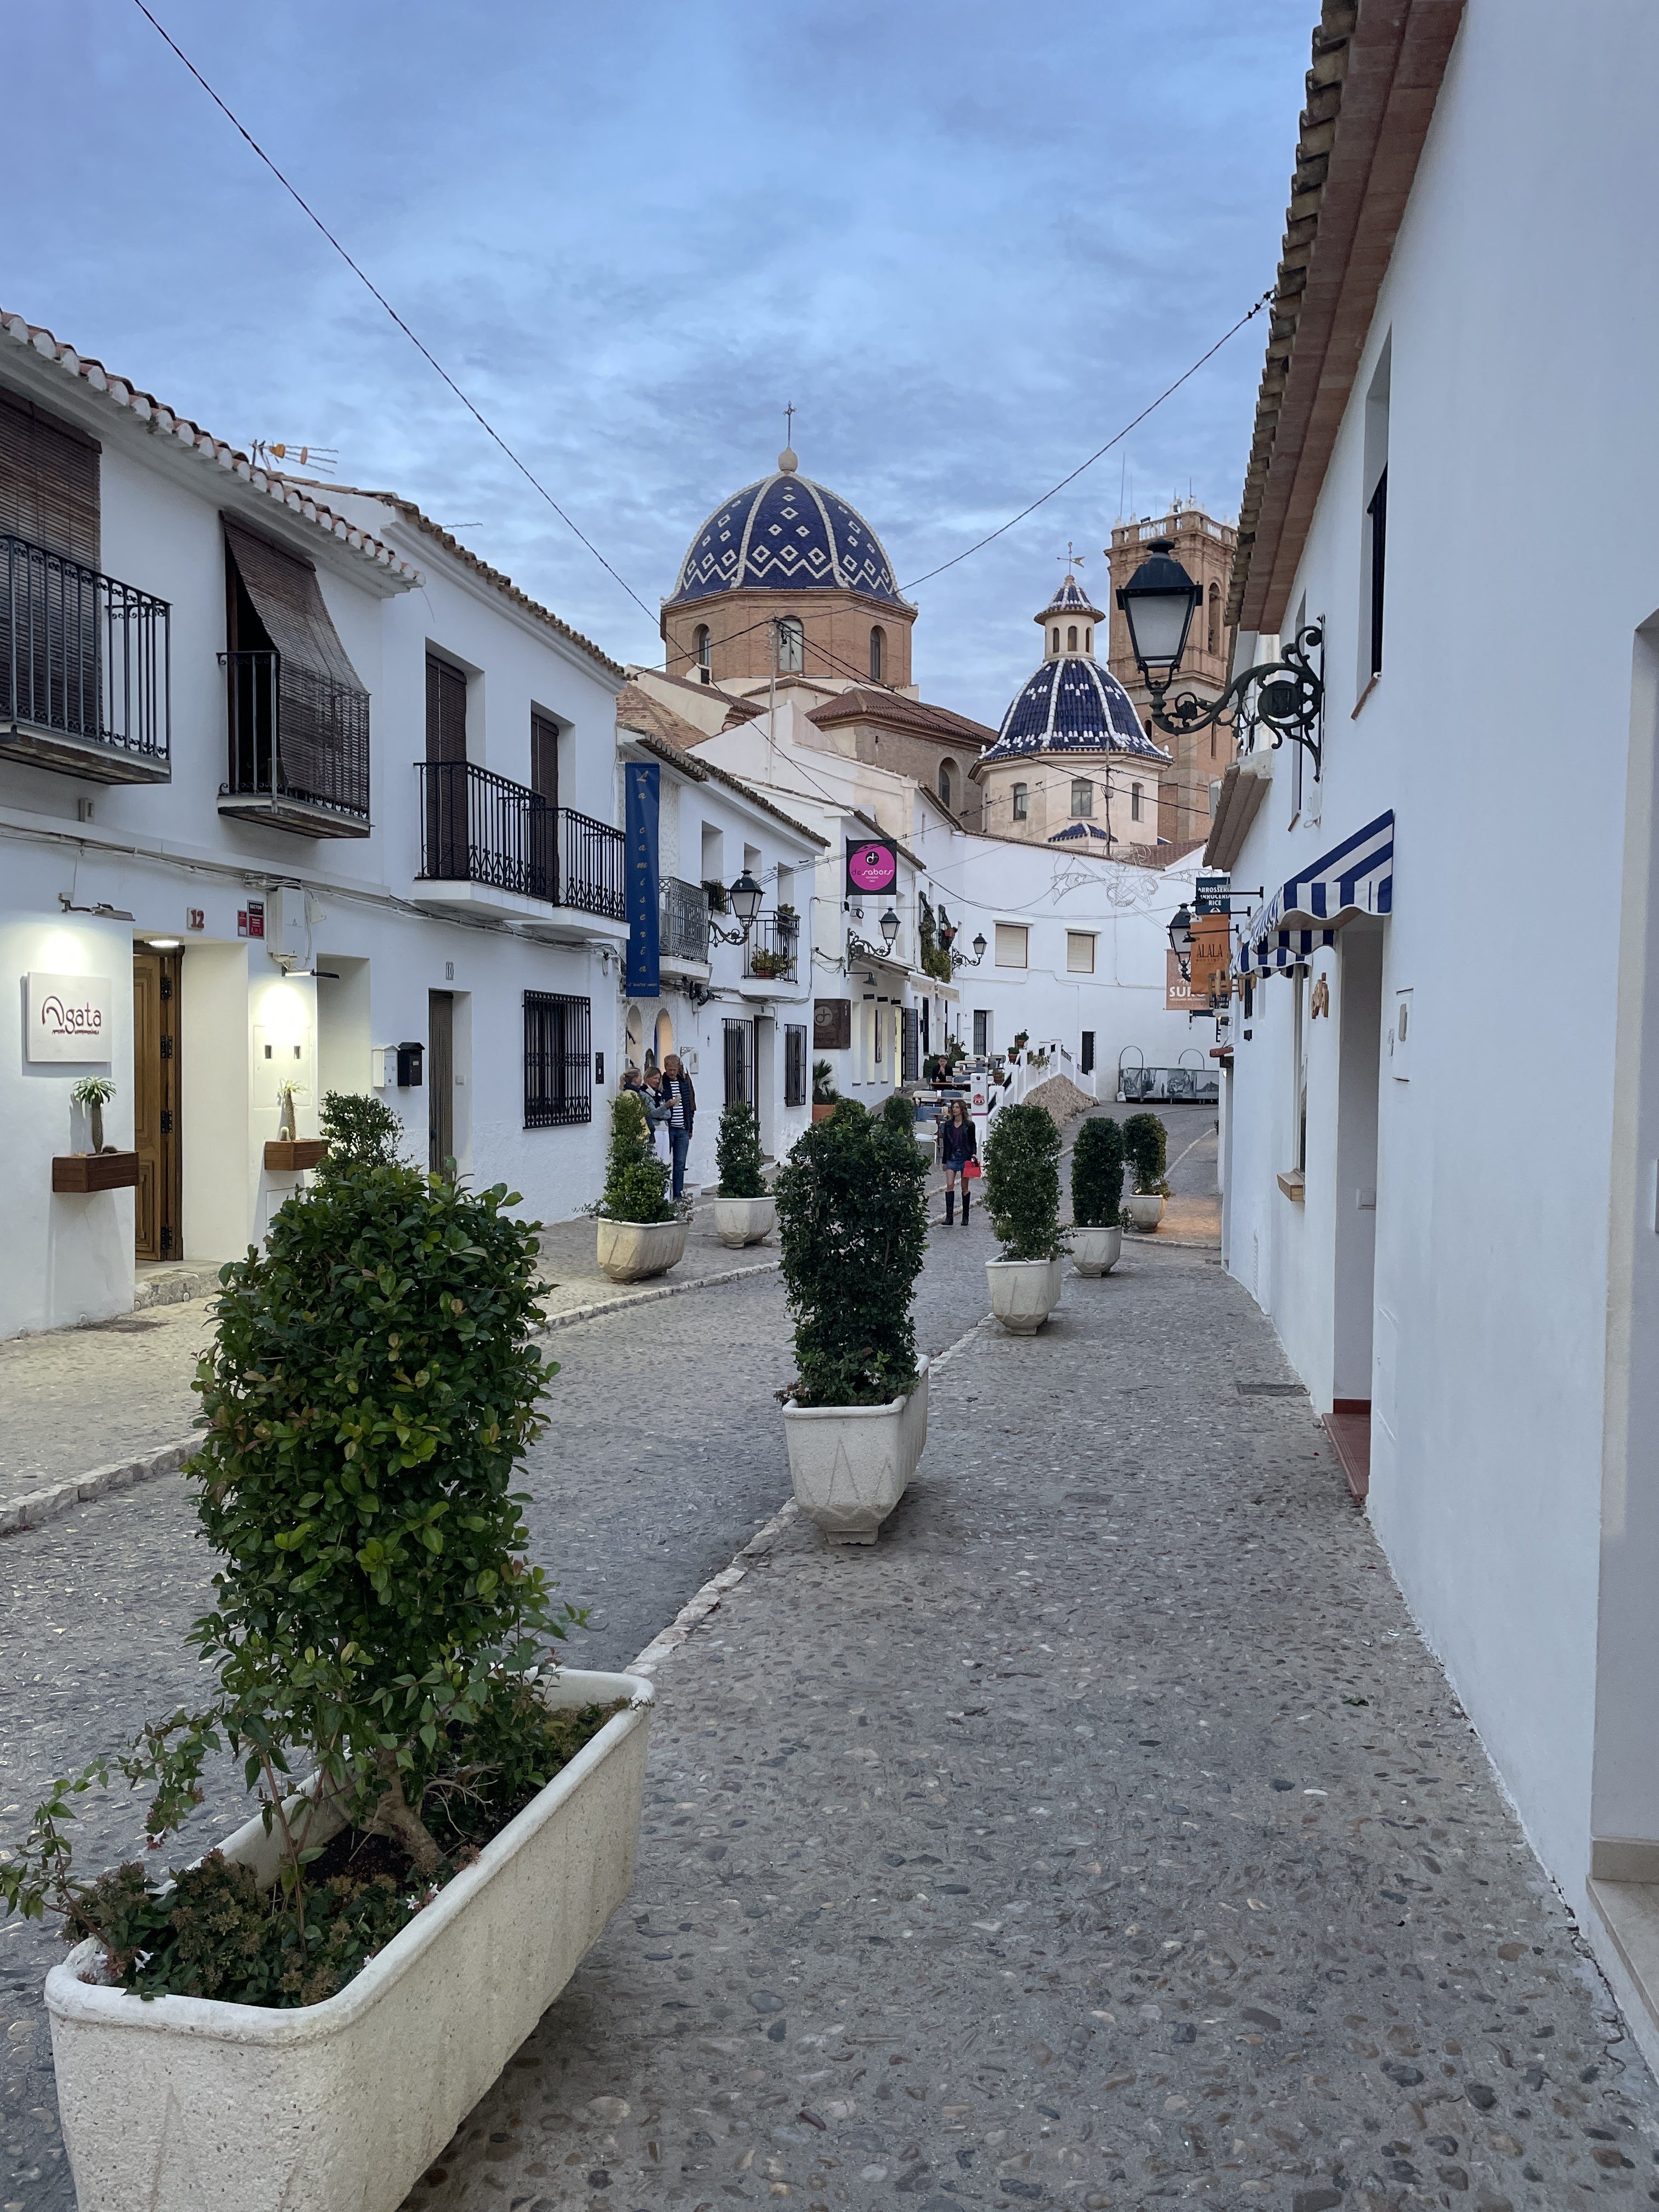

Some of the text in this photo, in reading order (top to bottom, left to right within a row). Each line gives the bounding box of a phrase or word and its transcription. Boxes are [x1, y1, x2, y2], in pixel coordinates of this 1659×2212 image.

[636, 770, 648, 799] La
[191, 909, 205, 928] 12
[1197, 944, 1223, 958] ALALA
[447, 964, 454, 977] 10
